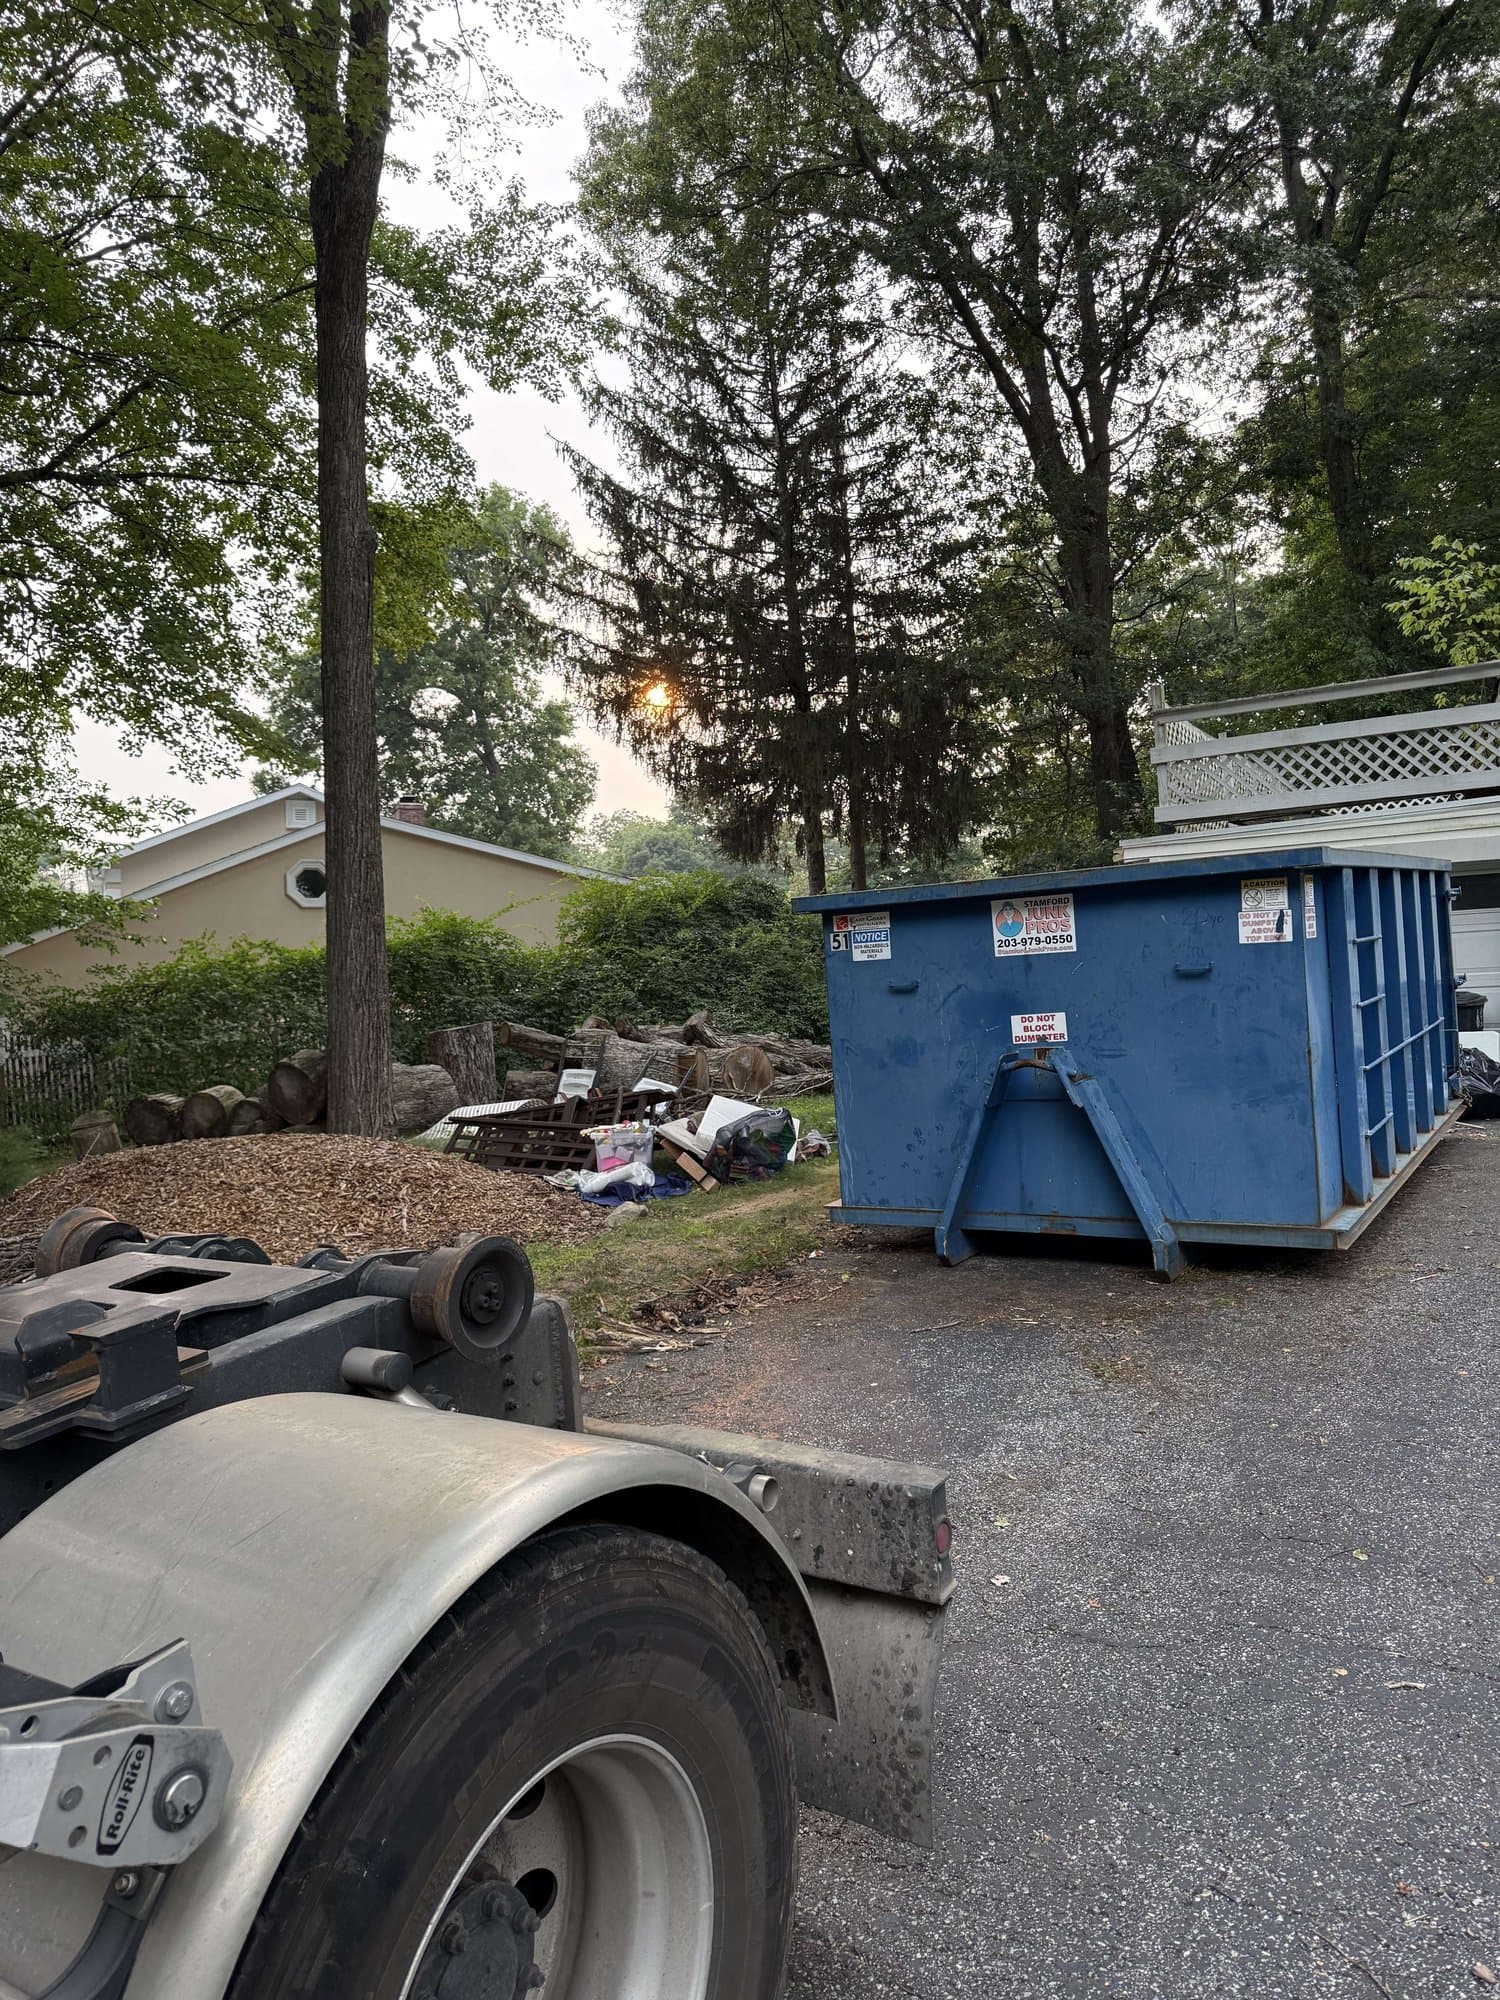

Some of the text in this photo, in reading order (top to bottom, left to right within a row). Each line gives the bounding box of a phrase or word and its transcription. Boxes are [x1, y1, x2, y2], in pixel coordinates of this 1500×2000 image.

[1249, 879, 1286, 888] CAUTION
[1024, 897, 1070, 908] STAMFORD
[1025, 905, 1071, 920] JUNK
[1025, 919, 1072, 934] PROS
[1242, 919, 1288, 927] DUMPSTR
[832, 933, 849, 950] 51
[854, 932, 887, 942] NOTICE
[997, 934, 1073, 948] 203-979-0550
[1036, 1014, 1056, 1022] NOT
[1023, 1024, 1056, 1032] BLOCK
[106, 1749, 146, 1839] Roll-Rite
